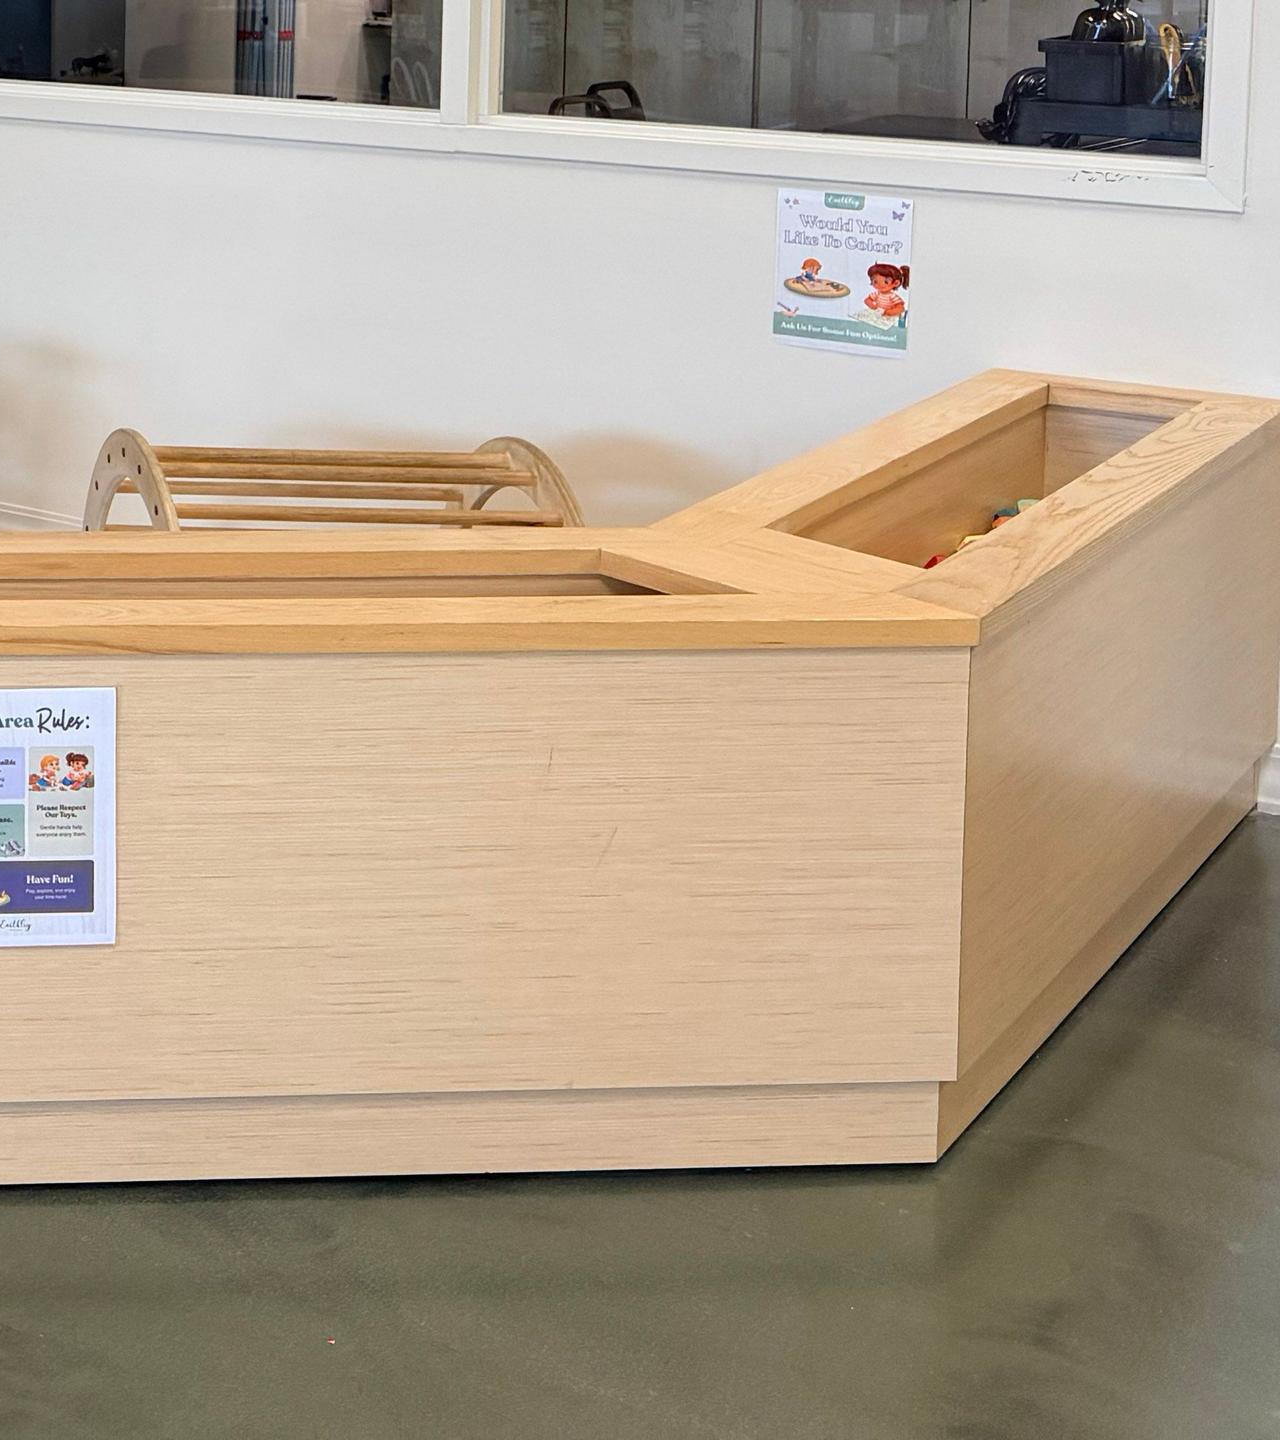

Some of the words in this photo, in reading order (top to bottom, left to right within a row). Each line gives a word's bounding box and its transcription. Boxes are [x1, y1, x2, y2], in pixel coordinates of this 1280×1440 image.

[799, 214, 853, 232] Would
[856, 219, 888, 236] You
[784, 229, 819, 246] Like
[821, 233, 842, 249] To
[845, 236, 903, 255] Color?
[781, 321, 795, 330] Ask
[36, 707, 90, 733] Rules:
[59, 804, 86, 812] Respect
[60, 811, 78, 819] Toys.
[26, 874, 50, 884] Have
[52, 873, 74, 884] Fun!
